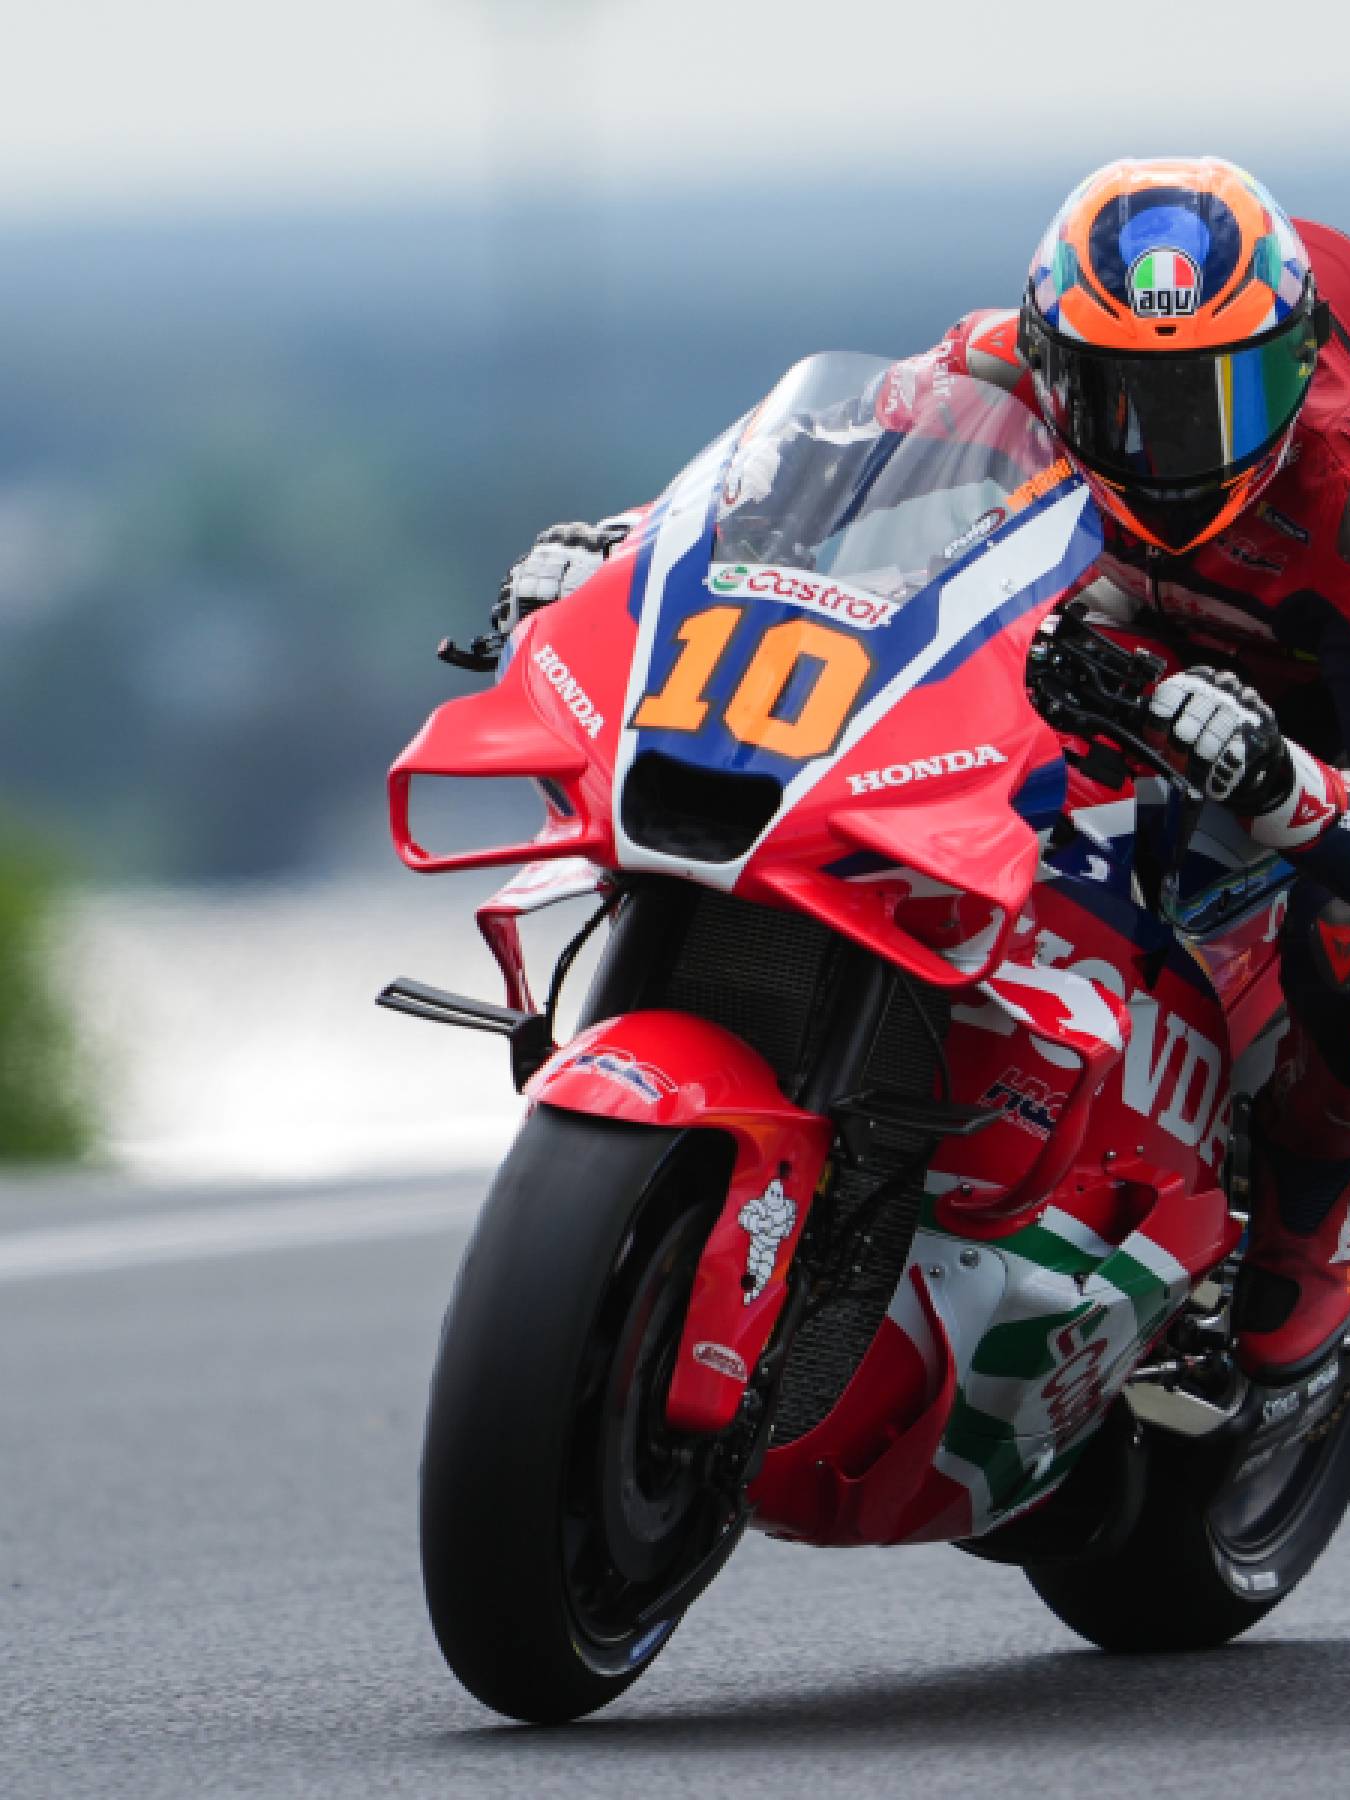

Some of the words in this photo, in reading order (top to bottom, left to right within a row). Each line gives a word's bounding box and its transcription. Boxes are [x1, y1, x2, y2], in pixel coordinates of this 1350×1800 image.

[747, 569, 890, 624] Castrol
[534, 644, 604, 739] HONDA
[634, 606, 872, 759] 10
[846, 743, 1007, 796] HONDA
